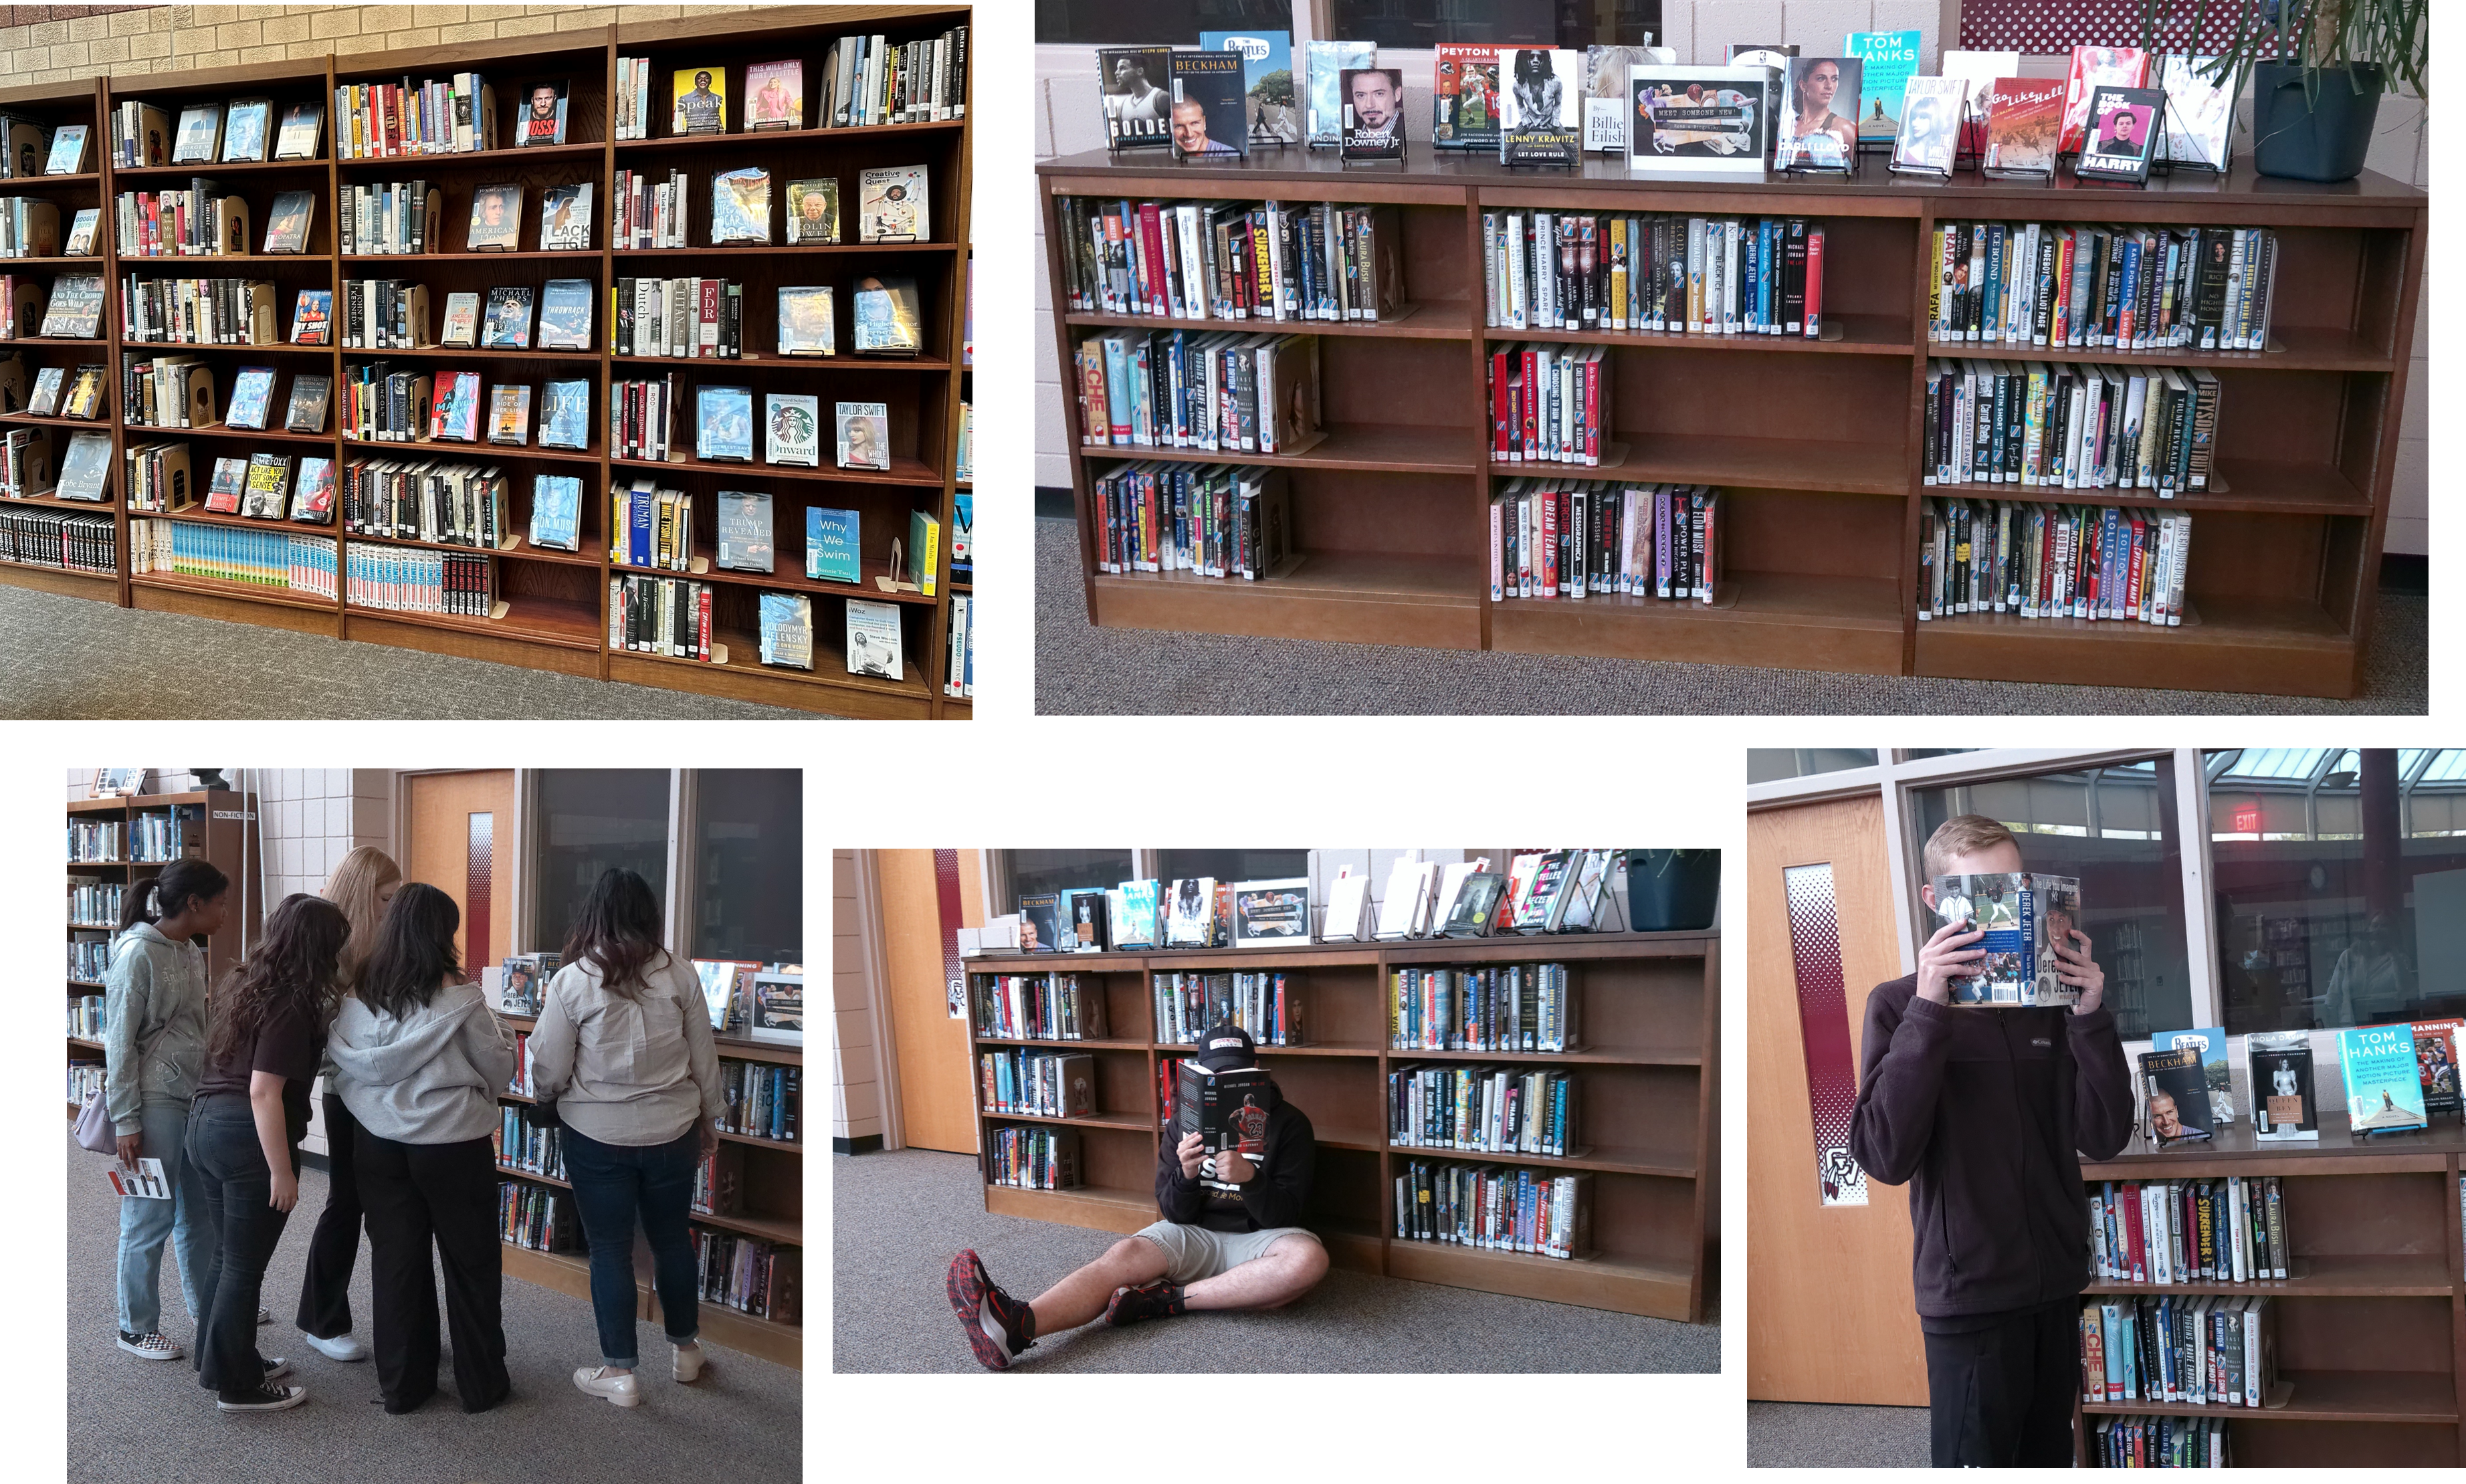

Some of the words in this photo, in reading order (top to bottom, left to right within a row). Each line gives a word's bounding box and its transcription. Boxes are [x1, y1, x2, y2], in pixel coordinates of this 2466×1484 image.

[1227, 41, 1267, 56] BEATLES
[1863, 37, 1902, 49] TOM
[1851, 49, 1915, 62] HANKS
[1175, 61, 1237, 71] BECKHAM
[776, 69, 799, 77] LITTLE
[1909, 79, 1936, 94] TAYLOR
[1938, 80, 1962, 94] SWIFT
[1992, 94, 2007, 104] Go
[2007, 90, 2035, 106] Like
[2035, 86, 2063, 104] Hell
[2101, 92, 2125, 101] THE
[230, 102, 248, 110] LAURA
[676, 96, 724, 111] Speak
[2098, 101, 2131, 109] BOOK
[1659, 109, 1679, 117] MEET
[386, 106, 395, 140] HITLER
[1110, 118, 1172, 137] GOLDE
[1591, 116, 1624, 130] Billie
[1354, 129, 1390, 138] Robert
[1506, 134, 1536, 143] LENNY
[1538, 134, 1575, 143] KRAVITZ
[1344, 137, 1387, 149] Downey
[1389, 137, 1399, 148] Jr
[1814, 142, 1849, 152] LLOYD
[175, 150, 210, 158] BUSH
[2083, 156, 2144, 171] HARRY
[865, 171, 900, 179] Creative
[164, 226, 173, 234] My
[552, 225, 589, 237] LACK
[1946, 232, 1955, 267] RAFA
[1253, 228, 1271, 294] SURRENDER
[1359, 259, 1369, 282] BUSH
[66, 291, 78, 299] THE
[637, 282, 649, 320] Dutch
[704, 287, 715, 320] FDR
[307, 321, 328, 329] SHOT
[1086, 370, 1104, 412] CHE
[837, 405, 862, 415] TAYLOR
[864, 405, 885, 415] SWIFT
[876, 442, 886, 450] THE
[867, 450, 886, 458] WHOLE
[271, 457, 286, 466] FOXX
[78, 480, 100, 490] Bryant
[251, 481, 272, 489] SENSE
[637, 496, 649, 528] TRUMAN
[1545, 500, 1554, 527] DREAM
[553, 517, 576, 532] MUSK
[730, 520, 763, 528] TRUMP
[819, 520, 847, 534] Why
[722, 526, 771, 537] REVEALED
[2106, 515, 2116, 558] SOLITO
[823, 535, 843, 546] We
[817, 548, 850, 562] Swim
[765, 623, 807, 635] VOLODYMYR
[765, 632, 808, 644] ZELENSKY
[2237, 814, 2256, 831] EXIT
[2034, 877, 2042, 889] The
[2043, 880, 2051, 890] Life
[2022, 893, 2031, 916] DEREK
[2023, 920, 2032, 941] JETER
[2037, 954, 2061, 973] Dere
[504, 990, 519, 998] Derek
[514, 999, 531, 1007] JETER
[2250, 1034, 2273, 1042] VIOLA
[2277, 1033, 2305, 1041] DAVIS
[2362, 1031, 2396, 1045] TOM
[2349, 1041, 2410, 1056] HANKS
[2148, 1054, 2196, 1069] BECKHAM
[2356, 1059, 2370, 1067] THE
[2372, 1058, 2394, 1066] MAKING
[2356, 1063, 2385, 1072] ANOTHER
[2388, 1062, 2409, 1070] MAJOR
[2356, 1071, 2382, 1079] MOTION
[2384, 1068, 2410, 1077] PICTURE
[2362, 1077, 2407, 1085] MASTERPIECE
[1248, 1123, 1263, 1136] 23
[2198, 1198, 2213, 1255] SURRENDER
[2088, 1333, 2103, 1372] CHE
